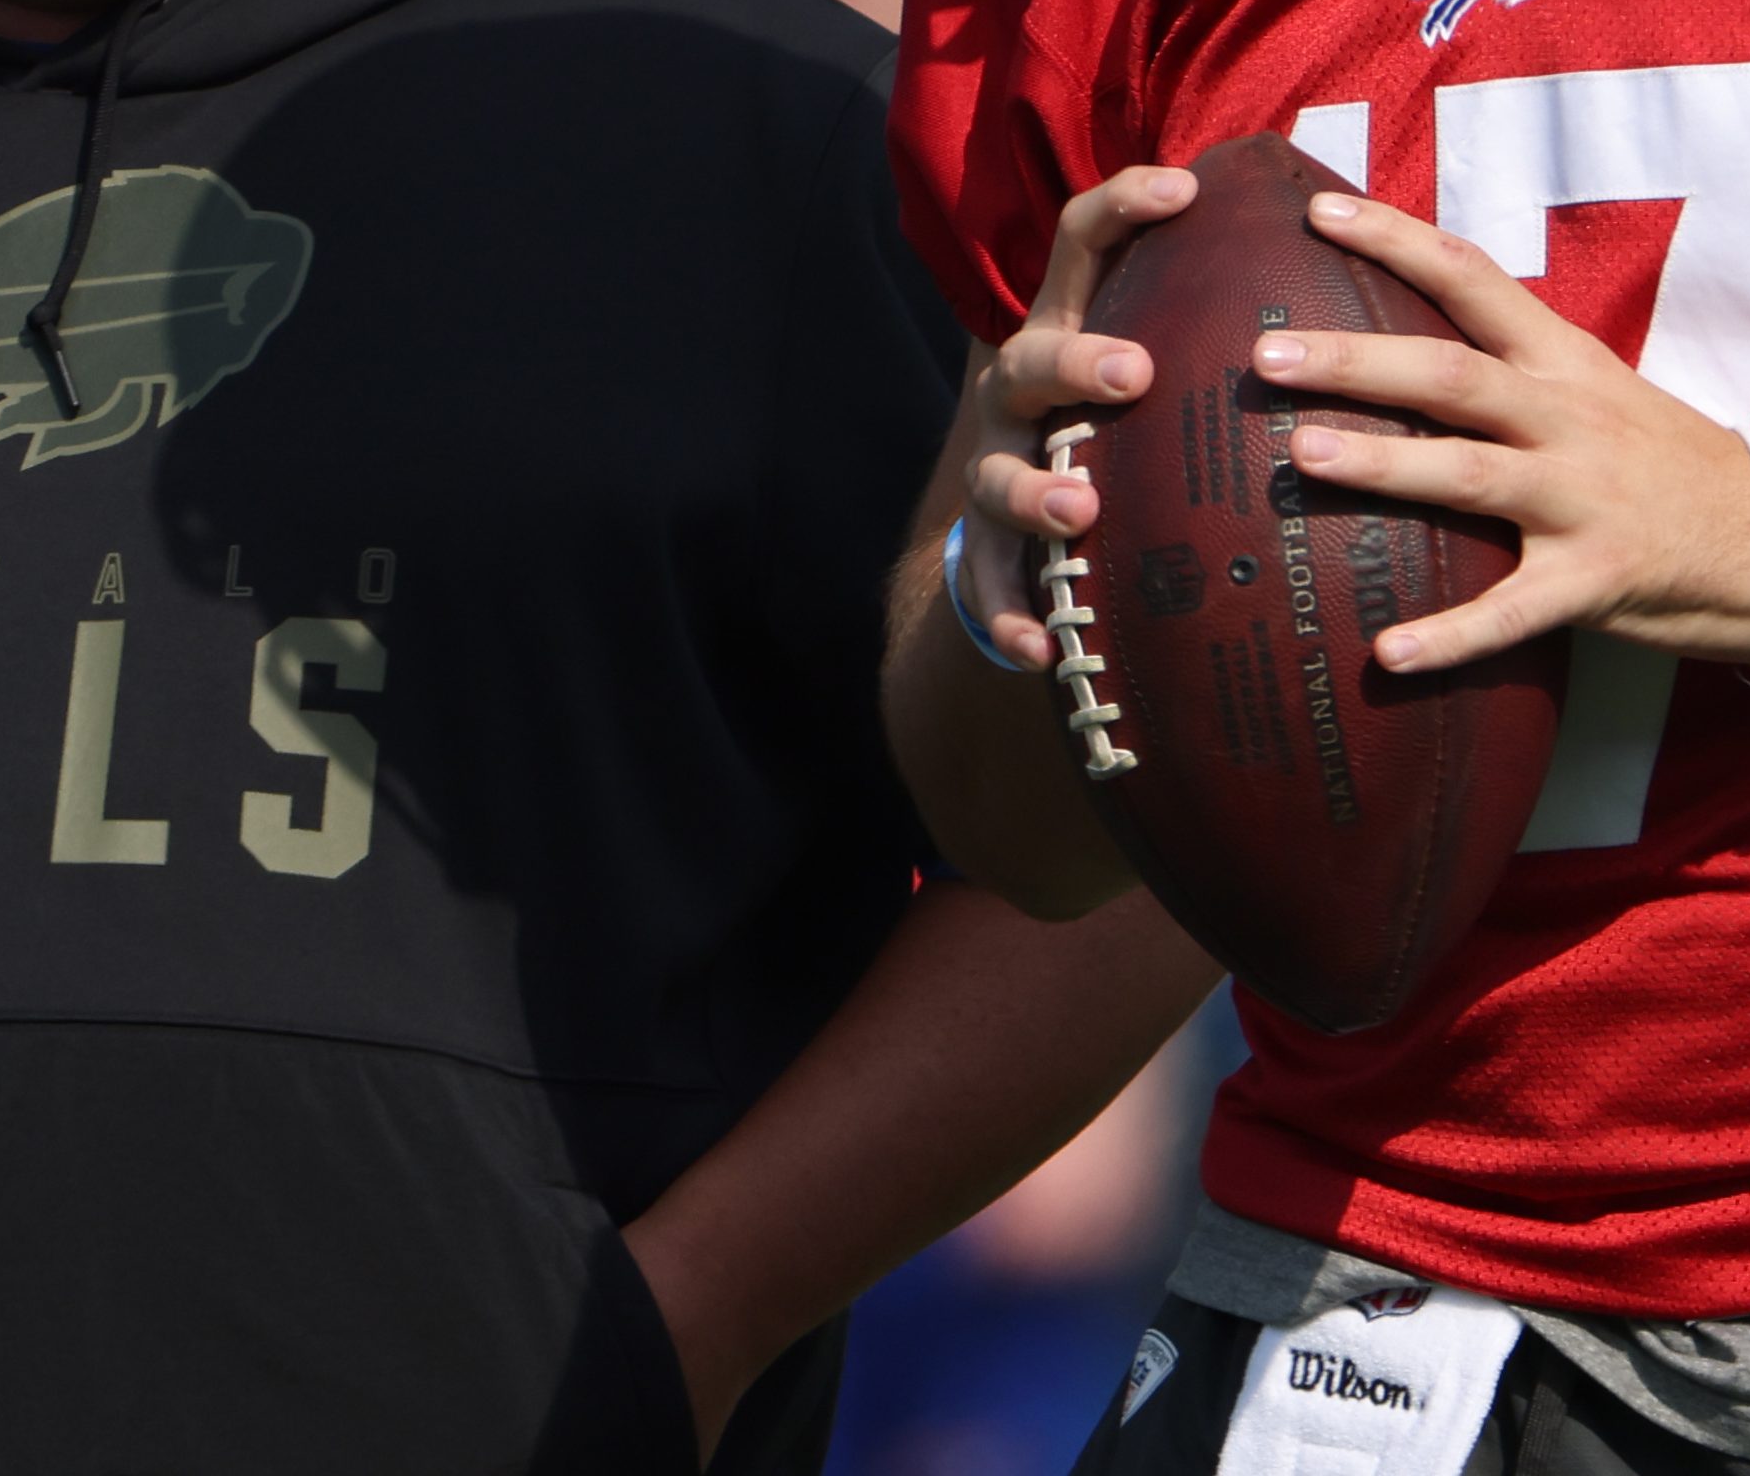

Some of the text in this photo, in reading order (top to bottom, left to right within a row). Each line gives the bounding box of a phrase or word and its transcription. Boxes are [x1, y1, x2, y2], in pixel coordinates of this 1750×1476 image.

[1260, 306, 1295, 434] LEE
[1303, 652, 1359, 823] NATIONAL
[1289, 1348, 1412, 1410] Wilson
